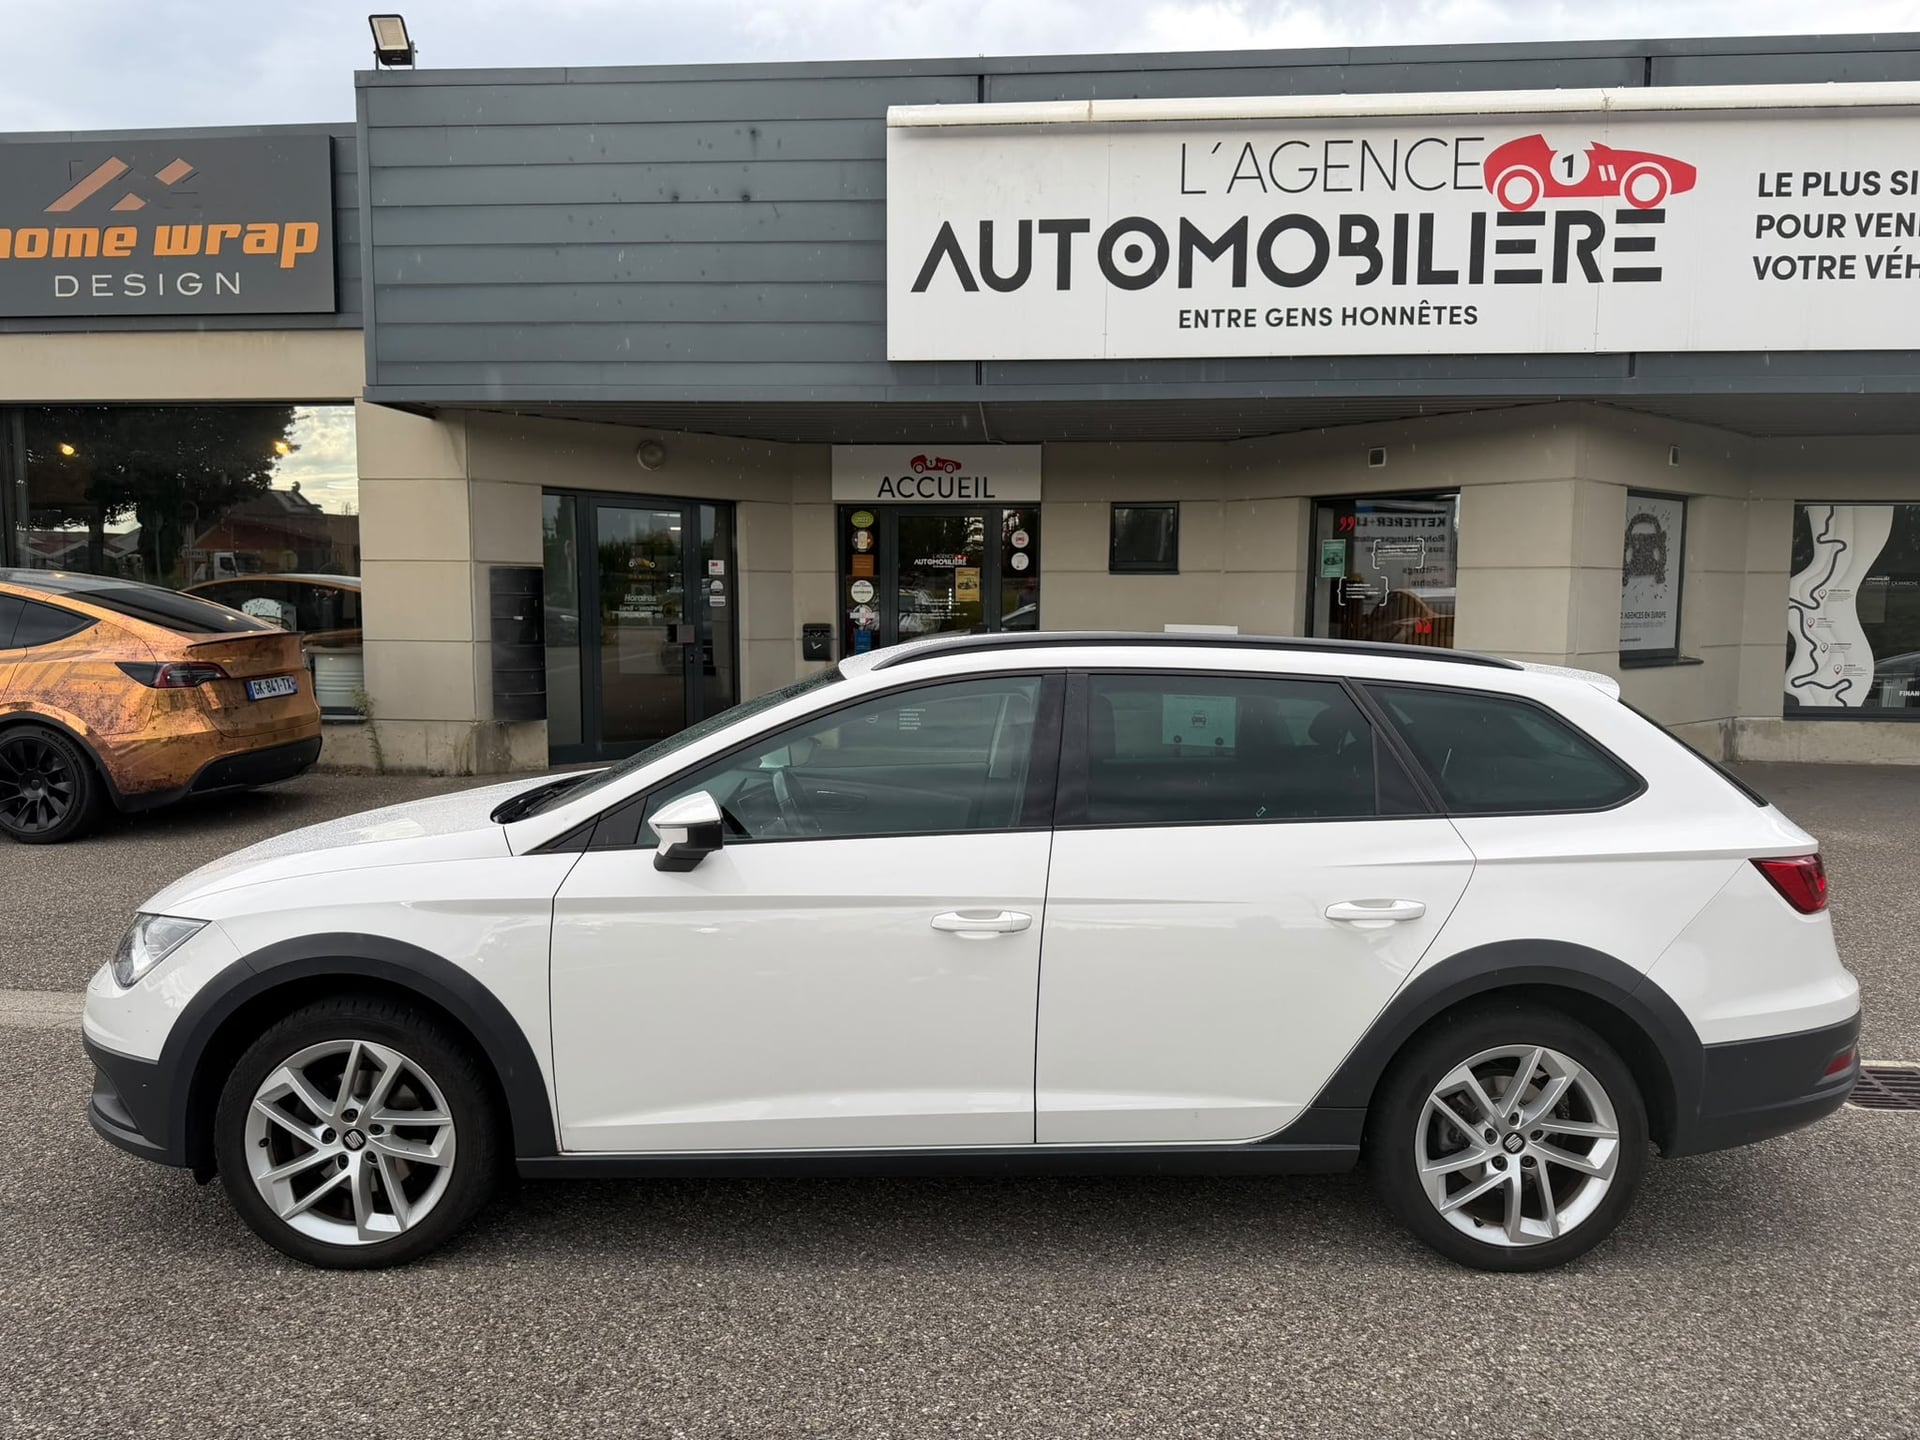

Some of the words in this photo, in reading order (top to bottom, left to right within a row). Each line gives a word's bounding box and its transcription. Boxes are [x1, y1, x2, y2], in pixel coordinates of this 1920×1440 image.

[1181, 136, 1485, 195] L'AGENCE
[1562, 153, 1574, 179] 1
[1758, 172, 1793, 198] LE
[1802, 171, 1881, 197] PLUS
[1755, 213, 1847, 239] POUR
[1854, 212, 1920, 238] VEN
[154, 222, 319, 269] wrap
[1752, 255, 1857, 281] VOTRE
[1864, 245, 1920, 280] VÉH
[54, 272, 241, 297] DESIGN
[1179, 308, 1257, 329] ENTRE
[1265, 307, 1333, 328] GENS
[1341, 300, 1478, 327] HONNÊTES
[877, 476, 996, 499] ACCUEIL
[624, 593, 657, 602] Horaires
